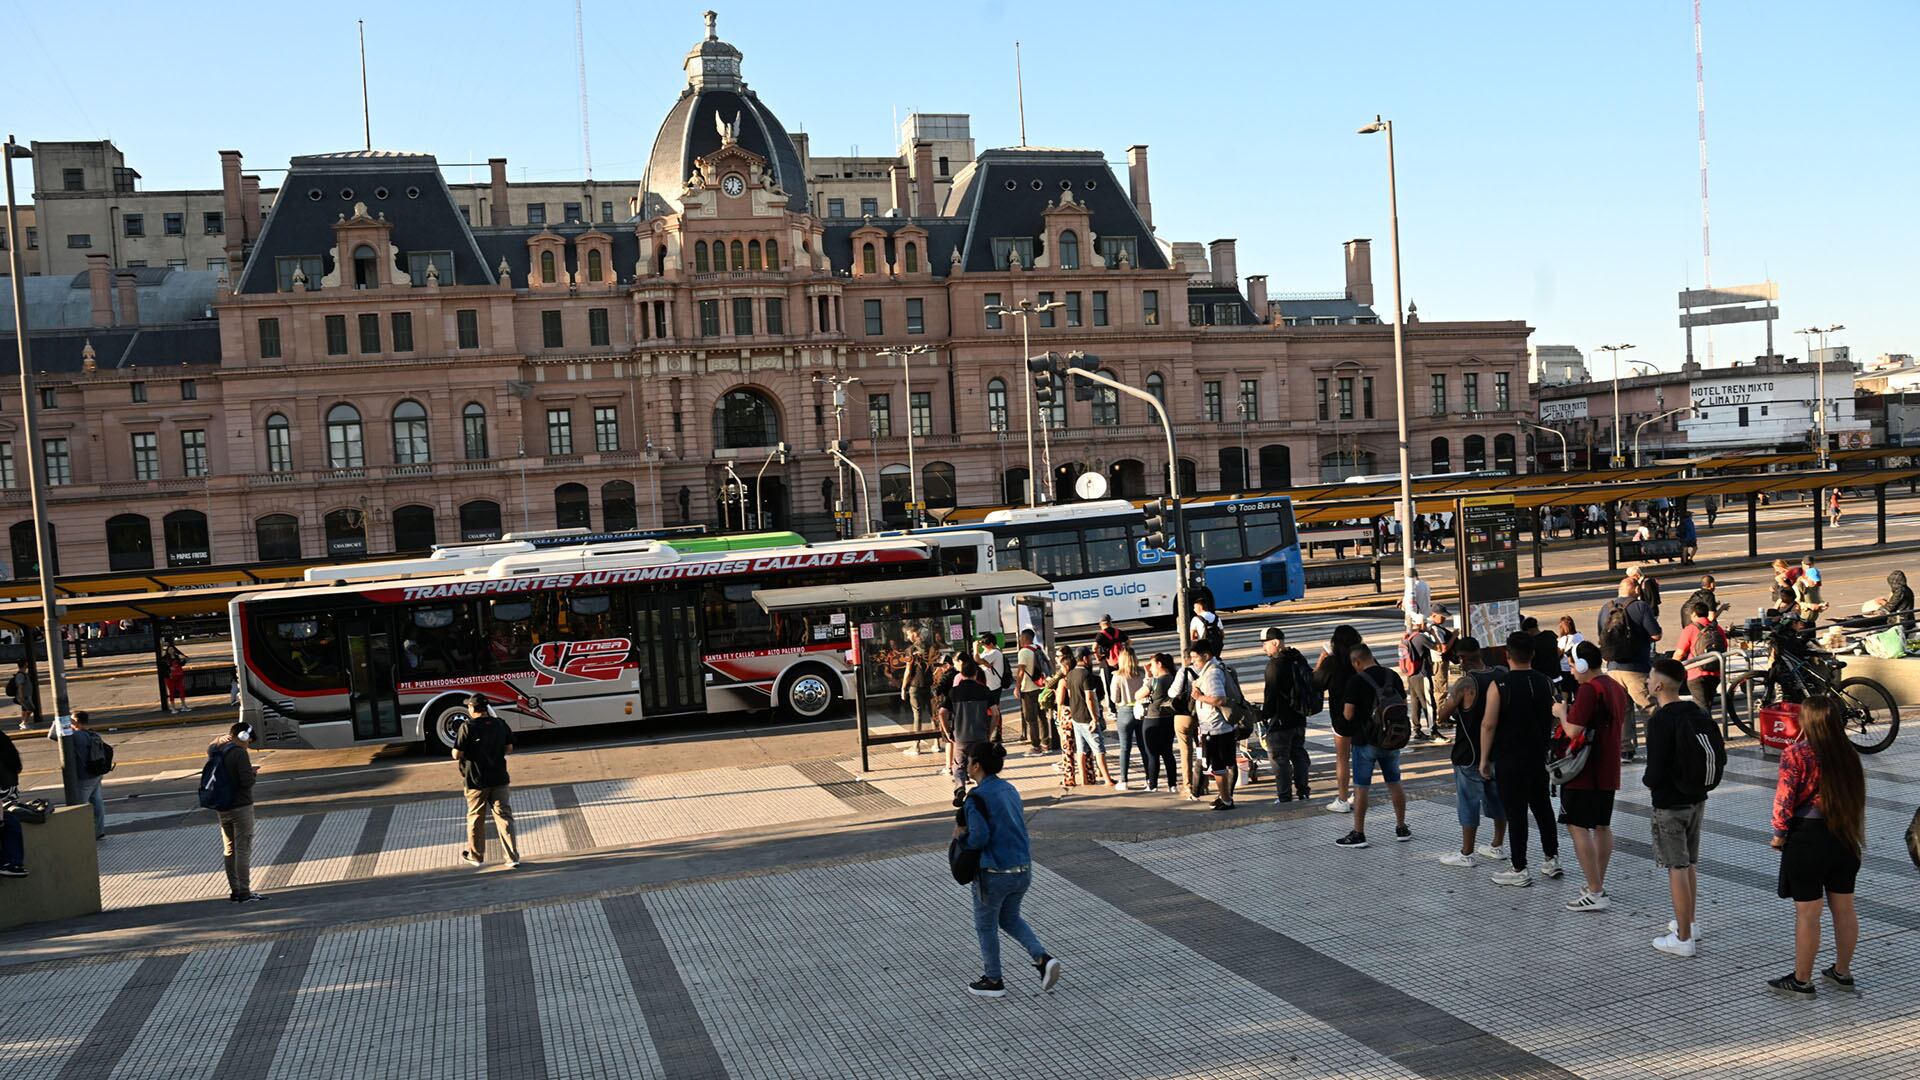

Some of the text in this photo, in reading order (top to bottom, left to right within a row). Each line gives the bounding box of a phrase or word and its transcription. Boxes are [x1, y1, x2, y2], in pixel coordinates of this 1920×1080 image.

[1691, 382, 1774, 397] HOTEL TREN MIXTO
[1709, 394, 1751, 405] LIMA 1717
[176, 552, 191, 560] PAPAS
[403, 550, 879, 601] TRANSPORTES AUTOMOTORES CALLAO S.A.
[1049, 588, 1100, 602] Tomas
[1103, 581, 1146, 597] Guido
[834, 627, 845, 636] 12
[576, 641, 623, 651] LINEA
[704, 654, 722, 662] SANTA
[735, 651, 755, 659] CALLAO
[767, 648, 780, 656] ALTO
[781, 646, 806, 654] PALERMO
[400, 681, 413, 689] PTE.
